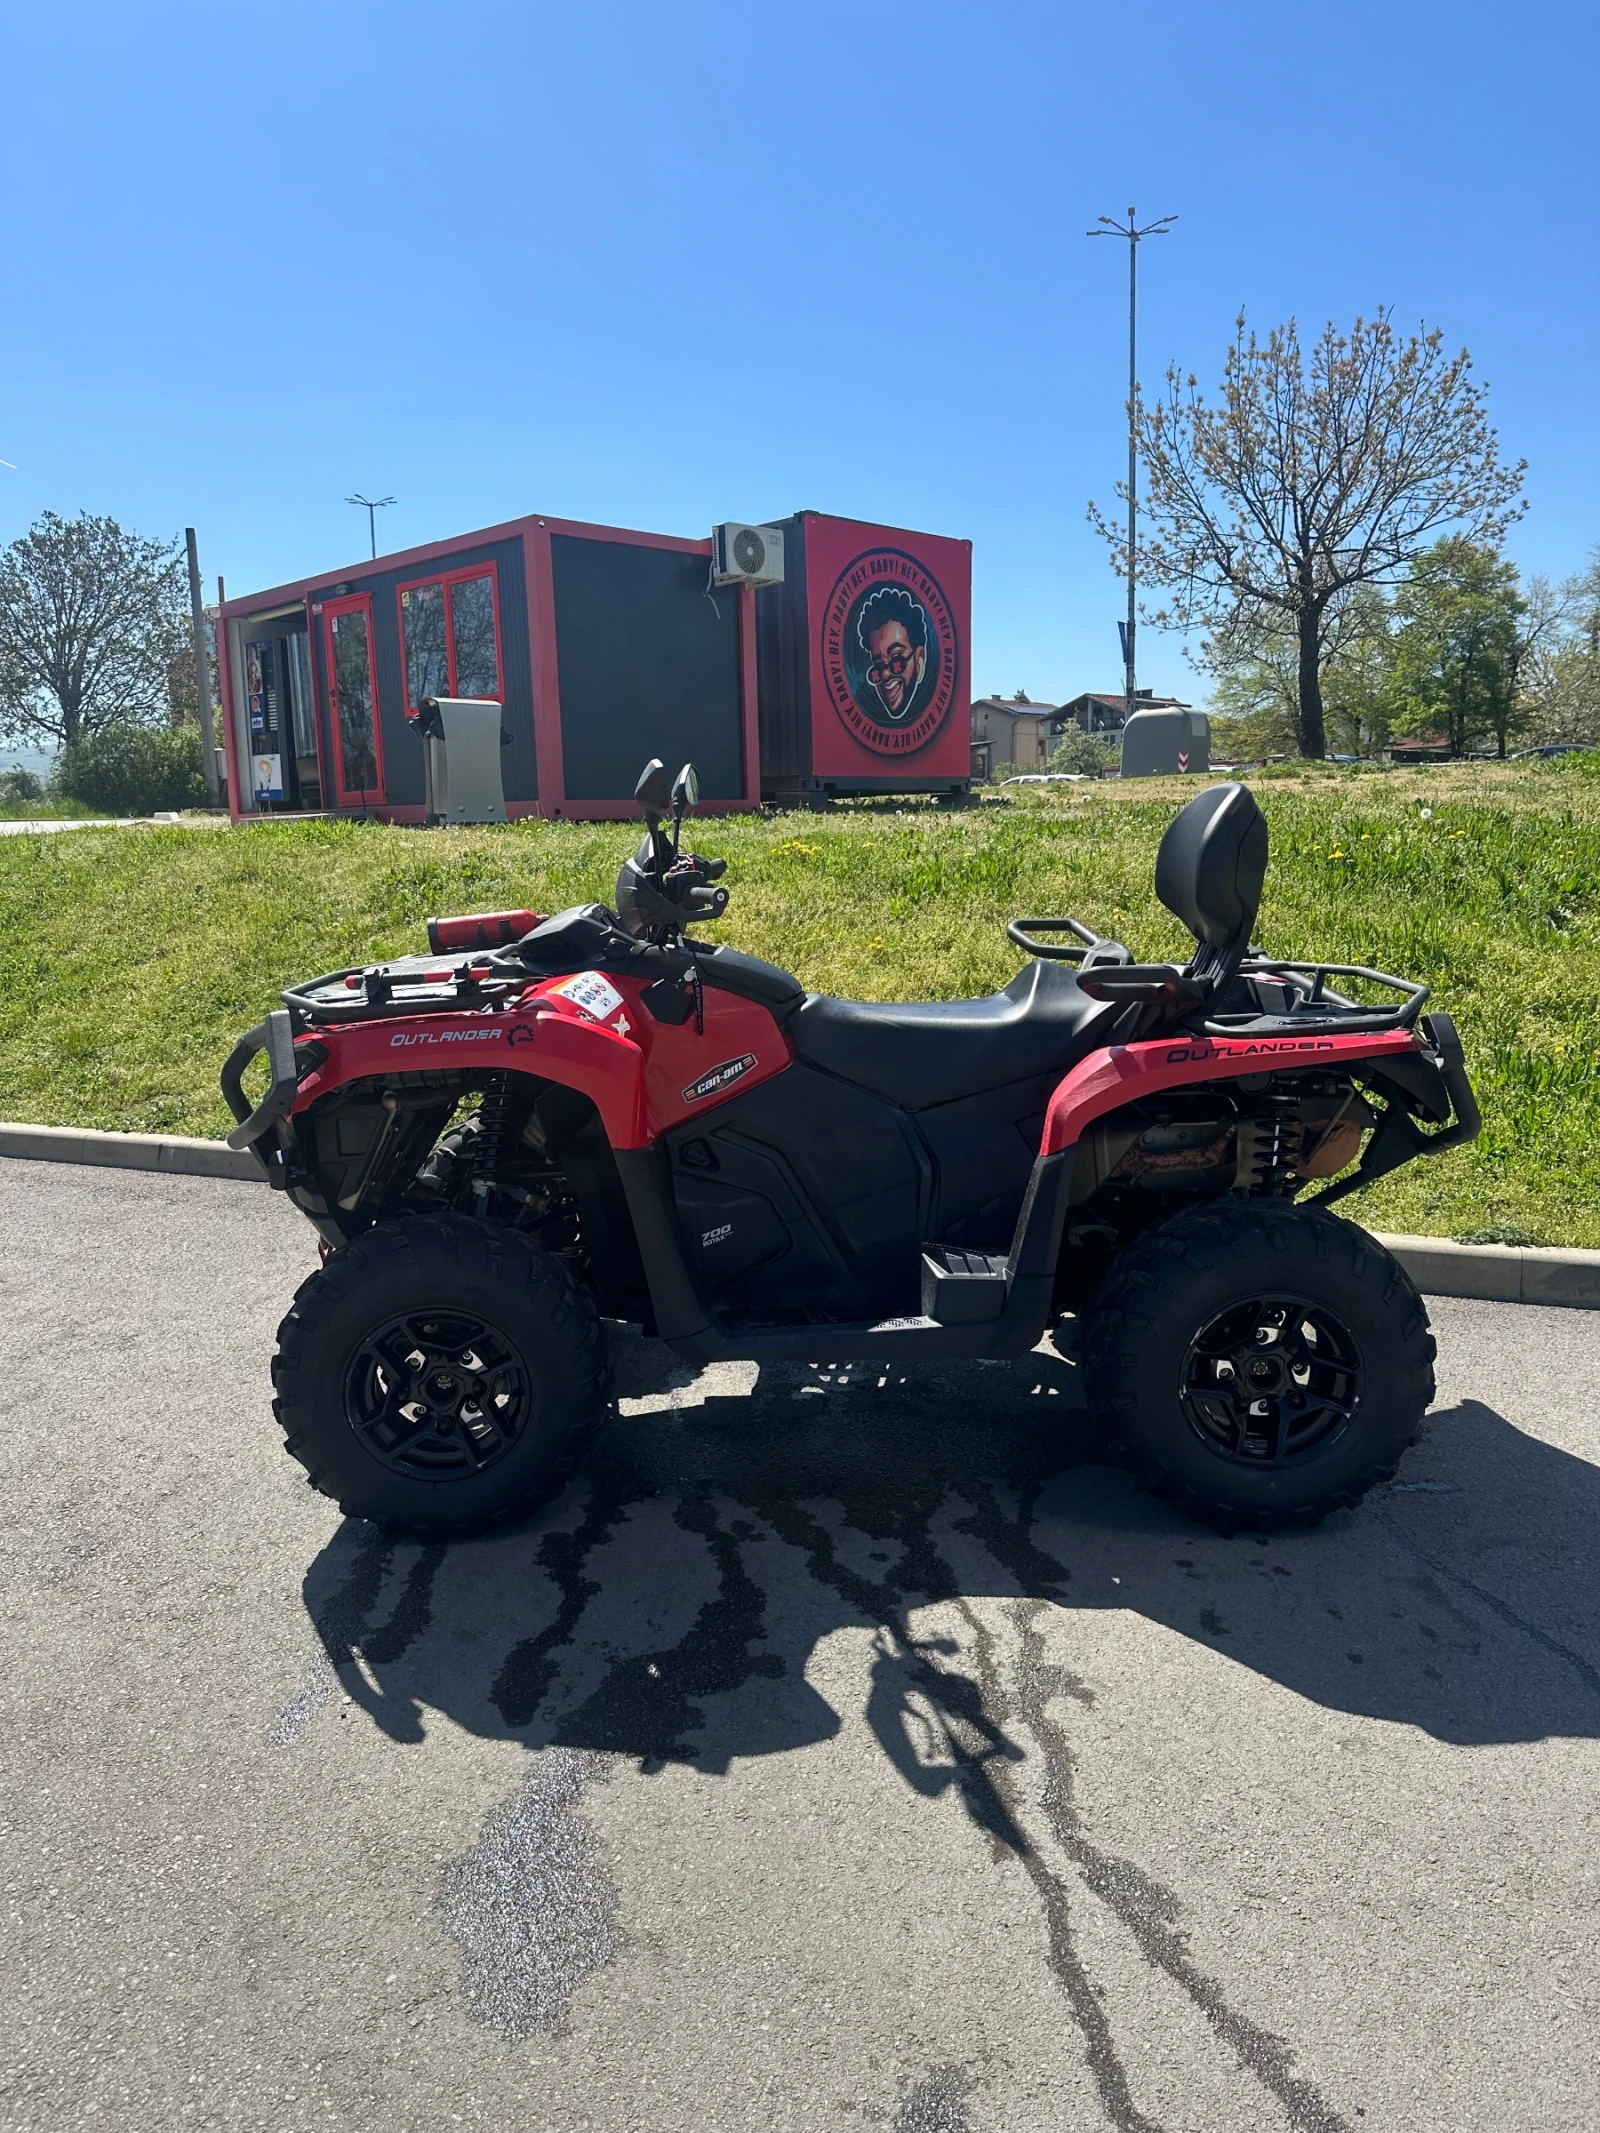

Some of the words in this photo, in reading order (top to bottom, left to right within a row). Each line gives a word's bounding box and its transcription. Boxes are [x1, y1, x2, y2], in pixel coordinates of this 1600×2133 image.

[390, 1028, 502, 1047] OUTLANDER
[1167, 1042, 1334, 1063] OUTLANDER
[697, 1062, 743, 1094] can-am
[702, 1224, 731, 1241] 700
[703, 1235, 725, 1247] ROTAX
